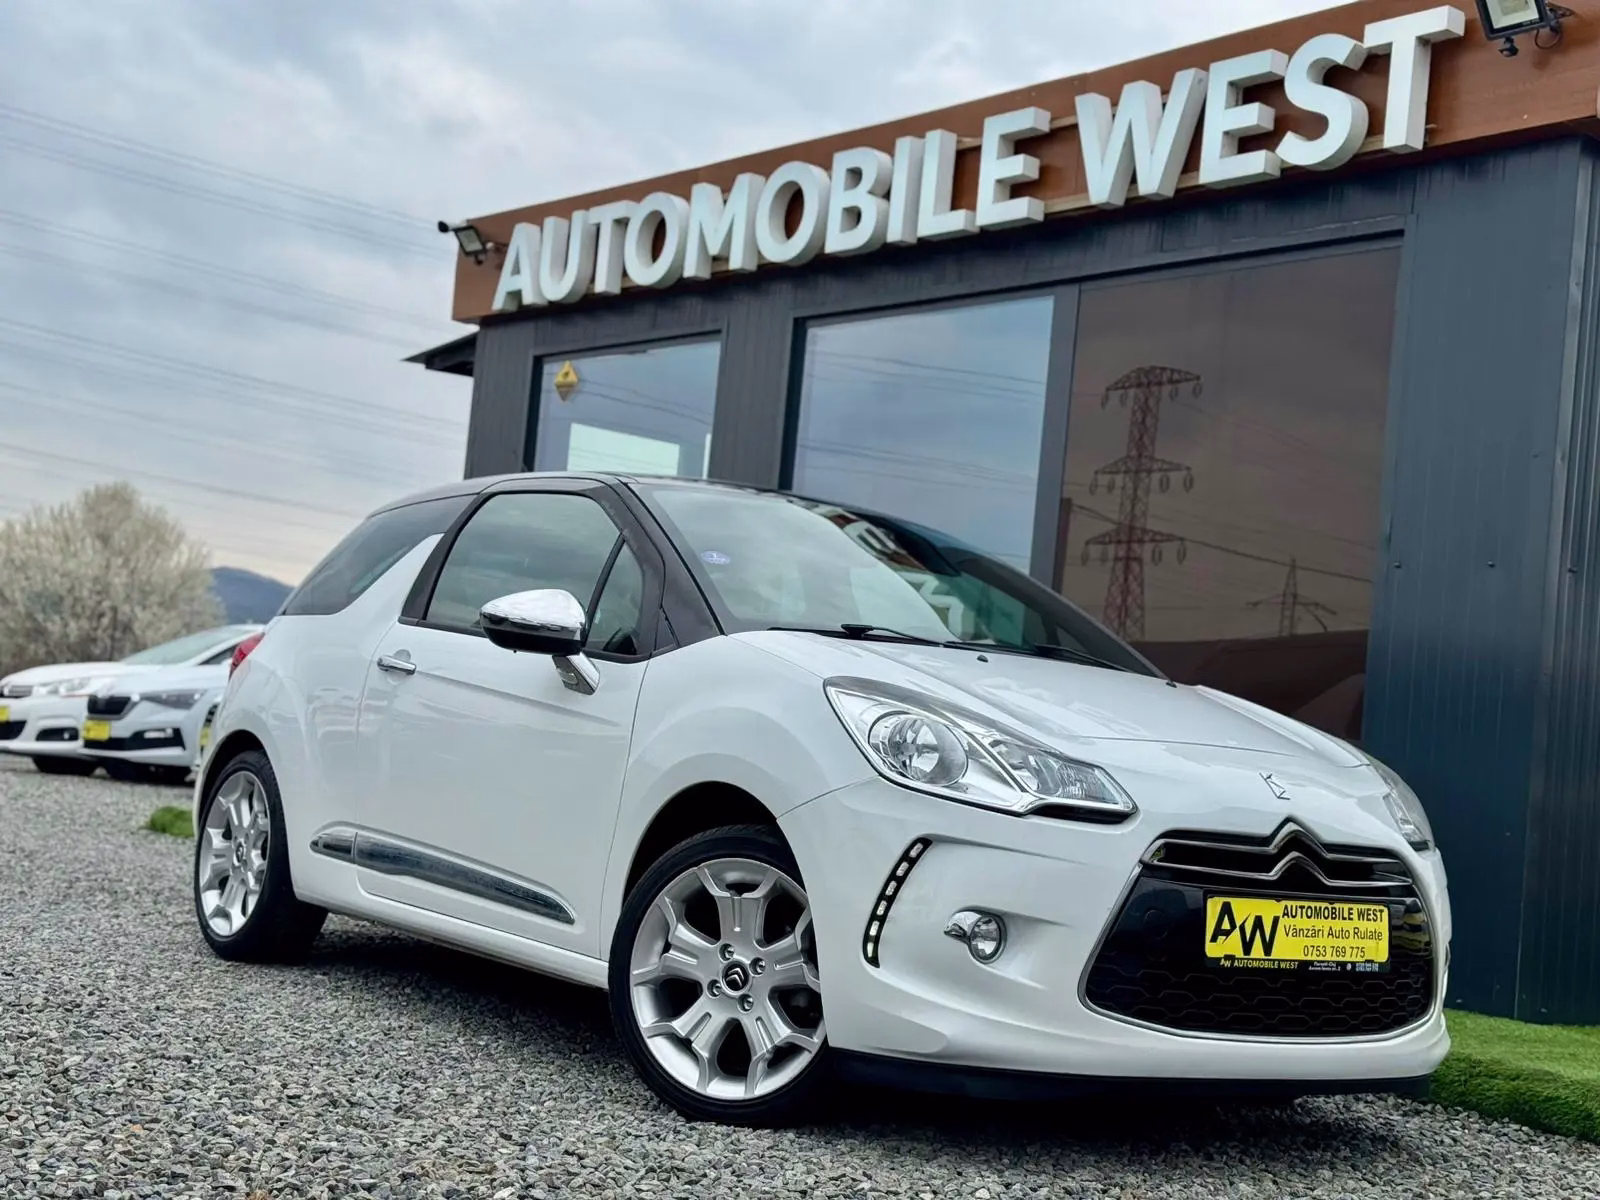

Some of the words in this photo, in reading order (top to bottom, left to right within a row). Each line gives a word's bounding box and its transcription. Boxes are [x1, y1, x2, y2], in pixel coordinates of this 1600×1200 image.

[491, 106, 1051, 312] AUTOMOBILE
[1075, 5, 1466, 209] WEST
[1282, 904, 1354, 921] AUTOMOBILE
[1357, 908, 1385, 923] WEST
[1327, 926, 1351, 940] Auto
[1353, 927, 1383, 941] Rulate
[1303, 945, 1327, 958] 0753
[1329, 946, 1347, 959] 769
[1349, 947, 1366, 959] 775
[1233, 959, 1279, 969] AUTOMOBILE
[1280, 961, 1299, 969] WEST
